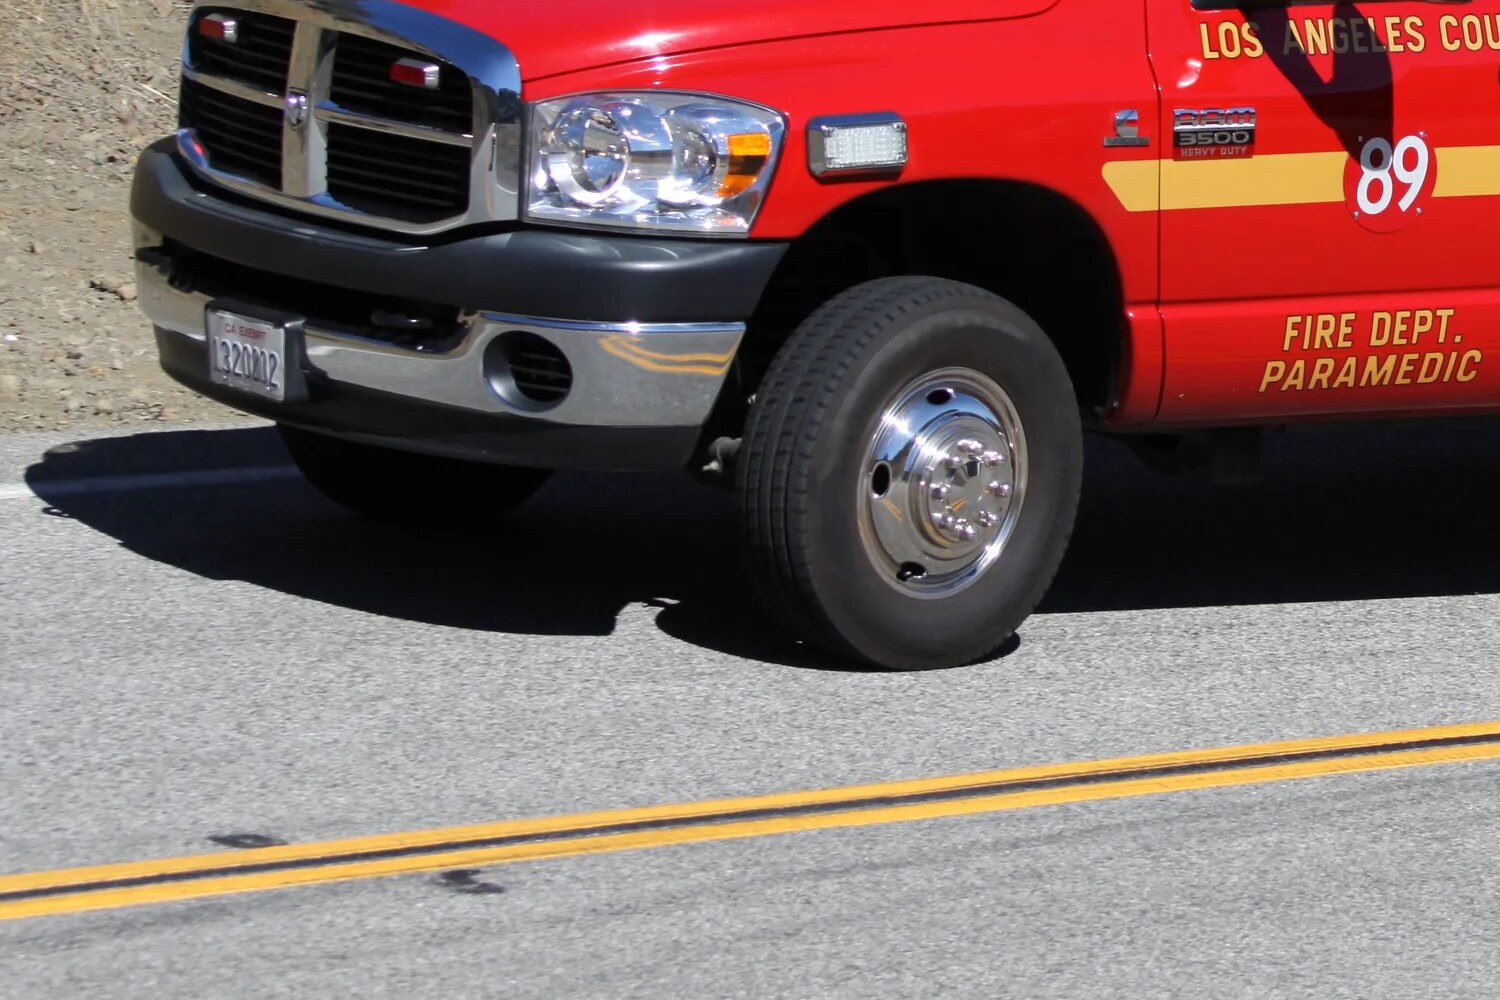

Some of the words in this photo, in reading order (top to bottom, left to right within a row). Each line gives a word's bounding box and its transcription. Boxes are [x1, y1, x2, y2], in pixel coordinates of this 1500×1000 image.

[1200, 21, 1264, 60] LOS
[1283, 15, 1426, 57] ANGELES
[1179, 131, 1250, 146] 3500
[1181, 147, 1216, 157] HEAVY
[1221, 146, 1248, 155] DUTY
[1356, 135, 1429, 215] 89
[1283, 313, 1356, 351] FIRE
[1369, 308, 1462, 347] DEPT.
[1258, 349, 1483, 392] PARAMEDIC
